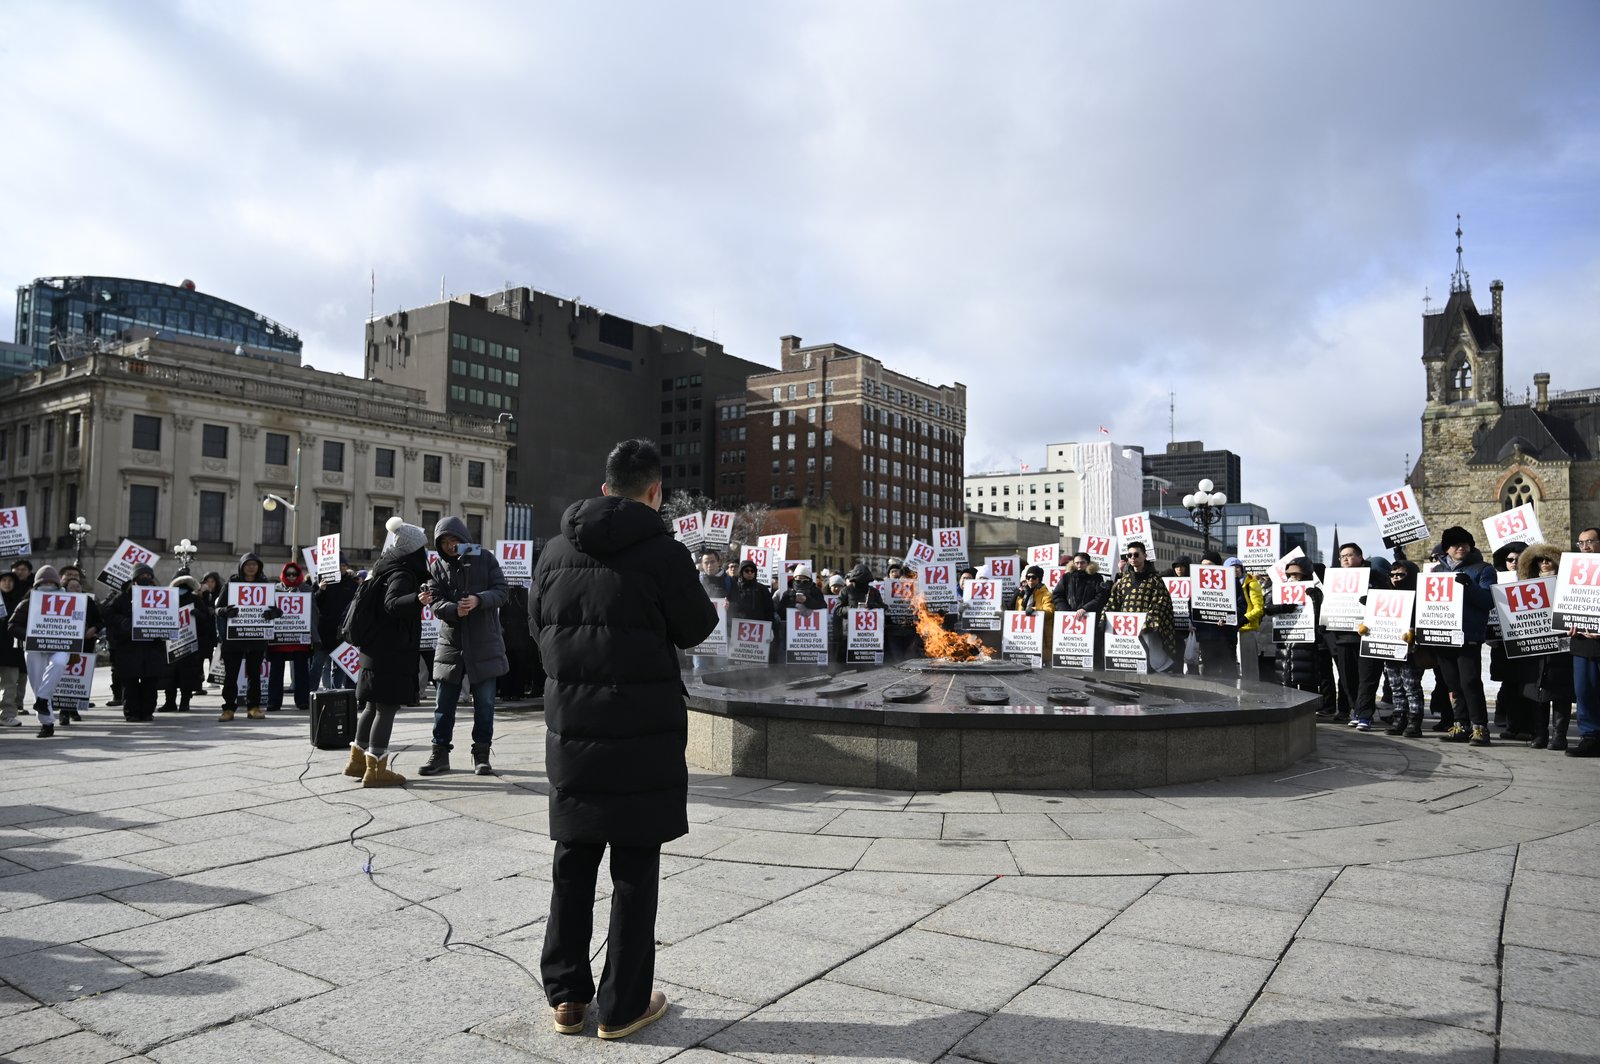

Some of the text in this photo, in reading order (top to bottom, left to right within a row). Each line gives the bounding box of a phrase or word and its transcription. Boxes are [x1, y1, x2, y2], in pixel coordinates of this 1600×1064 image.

[1381, 492, 1404, 516] 19
[713, 514, 727, 528] 31
[1384, 518, 1404, 528] WAITING
[1387, 512, 1408, 521] MONTHS
[1496, 512, 1524, 536] 35
[682, 518, 696, 533] 25
[1124, 517, 1141, 535] 18
[1393, 520, 1420, 532] RESPONSE
[942, 531, 958, 546] 38
[1088, 537, 1107, 555] 27
[1248, 529, 1268, 546] 43
[125, 547, 149, 563] 39
[322, 538, 334, 555] 34
[507, 544, 522, 559] 71
[916, 545, 931, 560] 19
[1036, 548, 1050, 561] 33
[928, 567, 945, 584] 72
[994, 560, 1010, 576] 37
[1574, 560, 1600, 586] 37
[1202, 570, 1223, 588] 33
[1334, 572, 1357, 592] 30
[241, 586, 263, 605] 30
[974, 583, 992, 599] 23
[1171, 581, 1189, 598] 20
[1282, 586, 1305, 605] 32
[1428, 578, 1450, 601] 31
[1511, 583, 1543, 611] 13
[46, 595, 71, 616] 17
[144, 590, 166, 608] 42
[282, 597, 300, 614] 65
[1376, 596, 1402, 618] 20
[1563, 596, 1591, 604] WAITING
[799, 614, 816, 629] 11
[858, 612, 875, 629] 33
[1015, 615, 1031, 632] 11
[1516, 611, 1548, 621] MONTHS
[740, 624, 760, 642] 34
[1064, 616, 1084, 634] 25
[1115, 617, 1136, 635] 33
[1510, 621, 1541, 629] WAITING
[1527, 637, 1558, 645] TIMELINES
